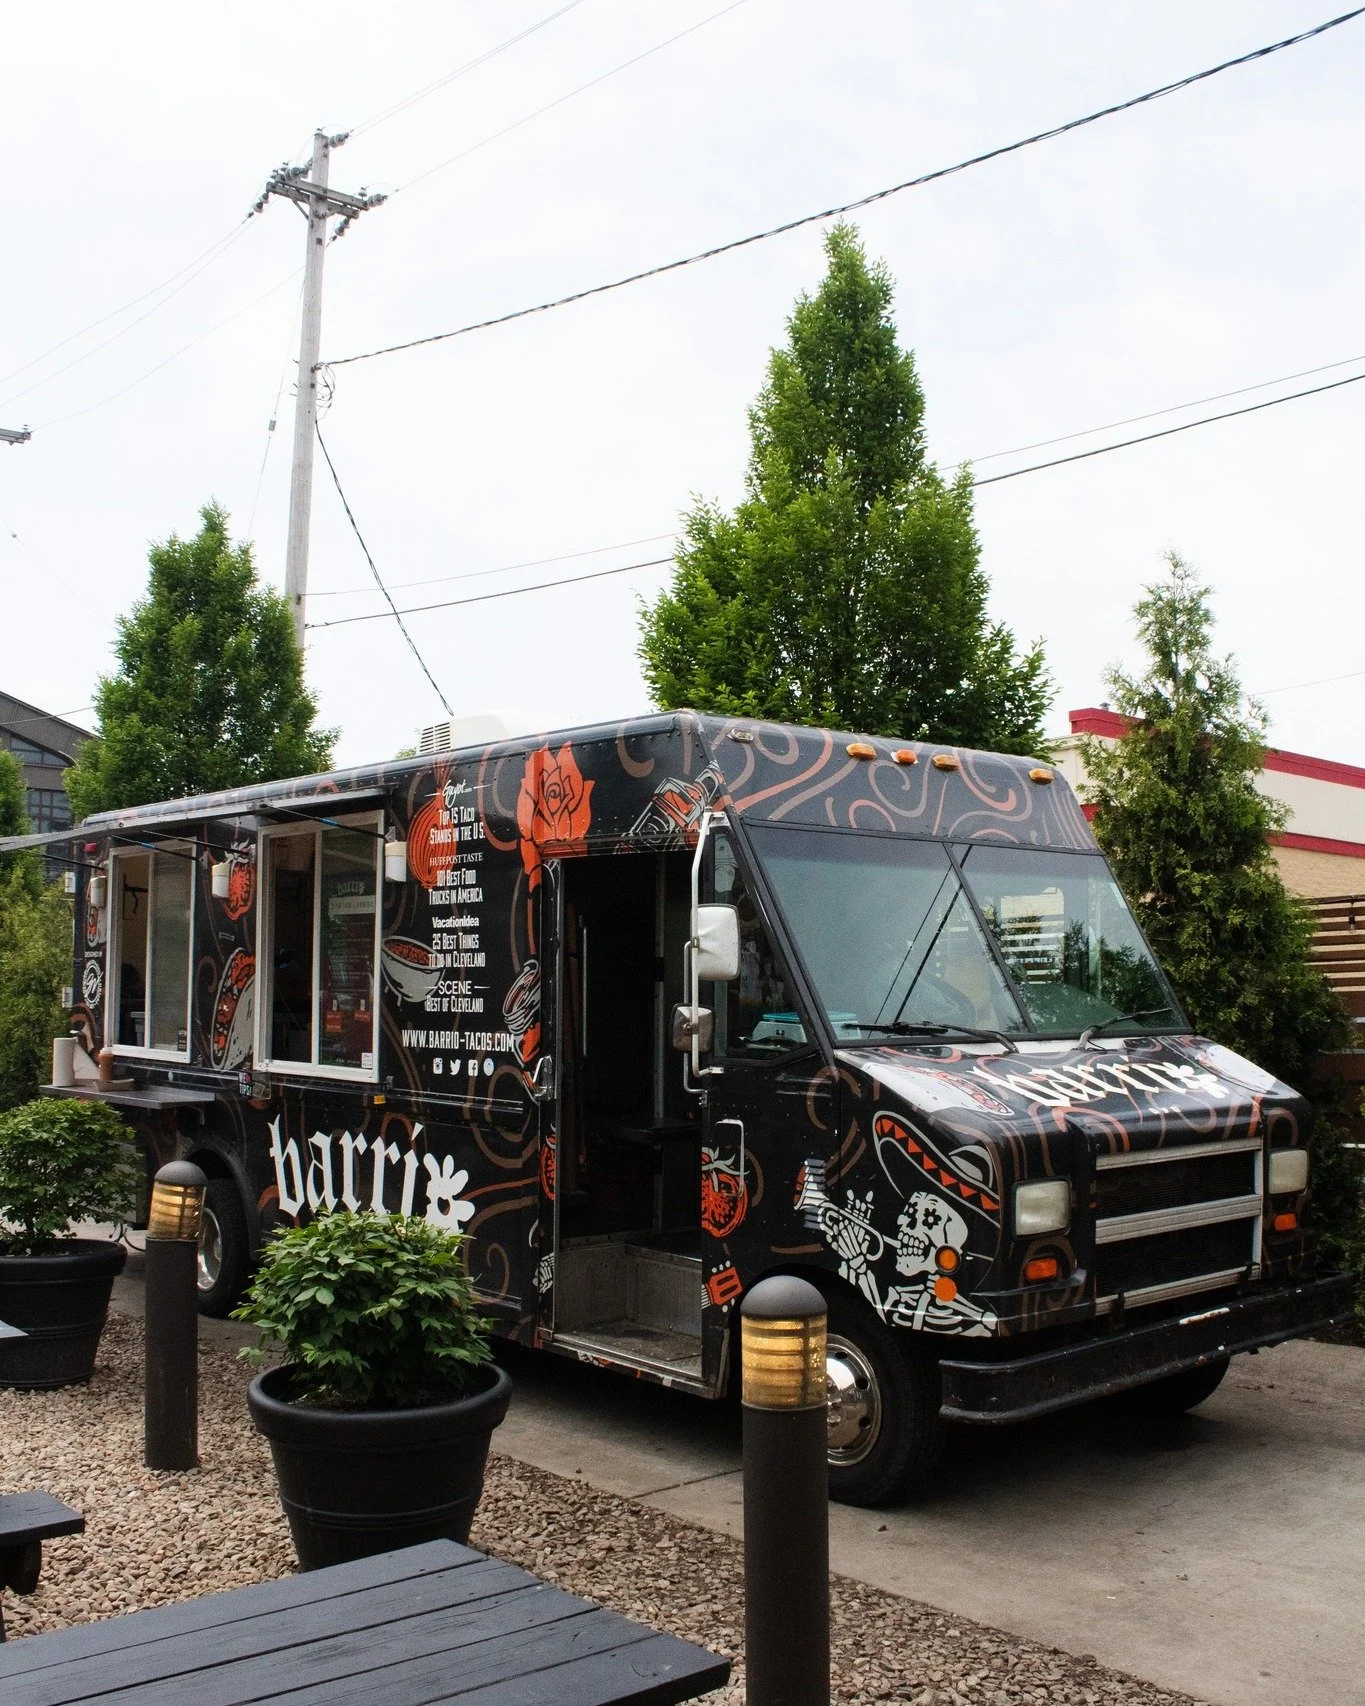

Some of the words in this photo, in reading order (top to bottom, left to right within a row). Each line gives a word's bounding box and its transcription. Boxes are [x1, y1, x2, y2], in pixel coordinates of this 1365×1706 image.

[451, 807, 459, 824] 15
[460, 806, 475, 823] TACO
[446, 869, 461, 886] BEST
[457, 887, 484, 903] AMERICA
[432, 932, 441, 950] 25
[442, 932, 457, 950] BEST
[452, 950, 486, 968] CLEVELAND
[438, 980, 472, 995] SCENE
[425, 995, 441, 1012] BEST
[450, 995, 484, 1013] CLEVELAND
[402, 1029, 515, 1053] WWW.BARRIO-TACOS.COM
